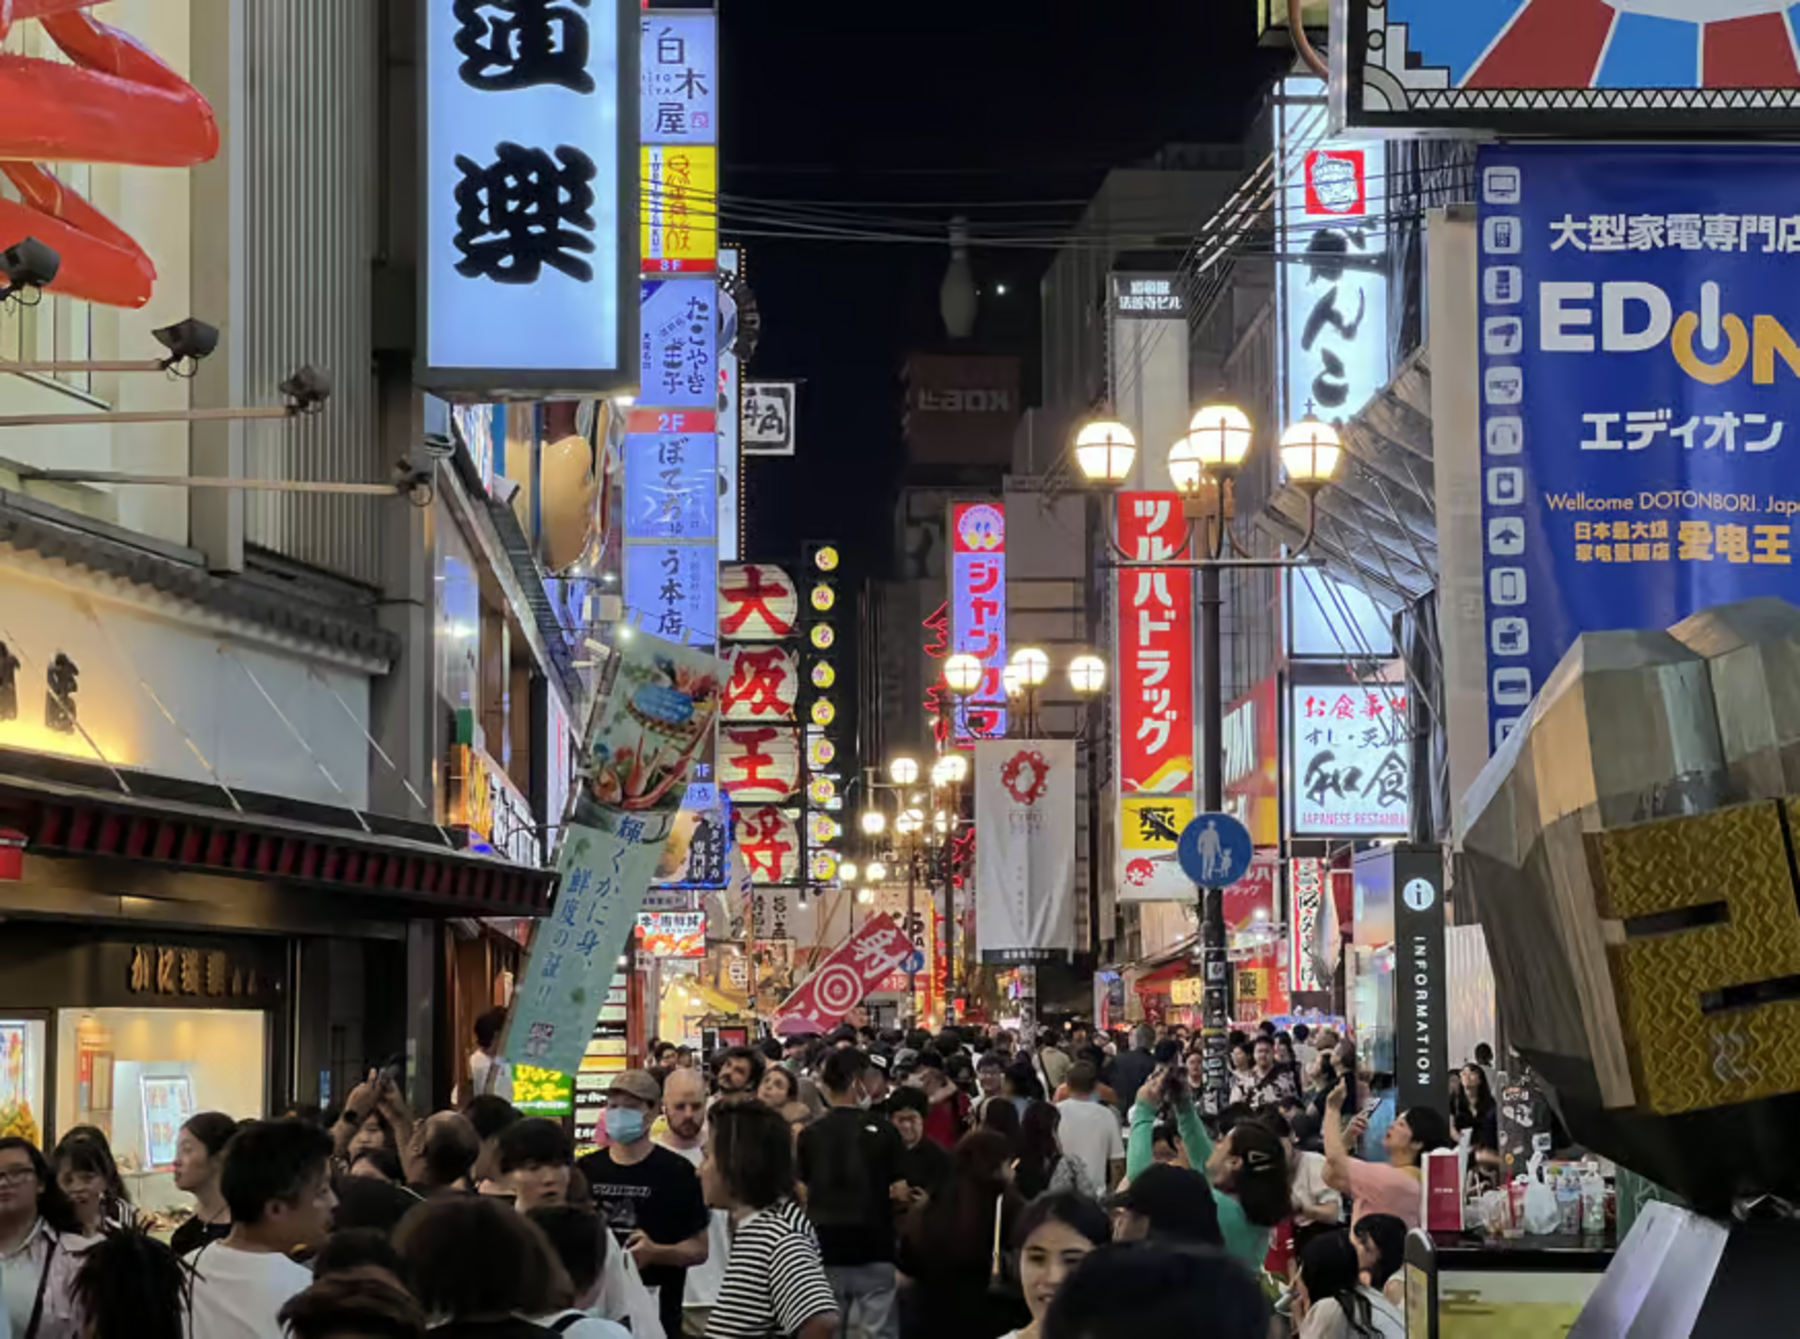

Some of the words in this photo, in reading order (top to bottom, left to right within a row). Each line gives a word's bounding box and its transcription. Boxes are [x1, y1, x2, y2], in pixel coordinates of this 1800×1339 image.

[655, 27, 709, 134] 白木屋
[661, 259, 682, 271] 3F
[1539, 281, 1800, 384] EDION
[658, 414, 684, 432] 2F
[1580, 408, 1784, 452] エディオン
[1546, 491, 1634, 511] Wellcome
[1765, 495, 1800, 518] Jap
[1133, 500, 1177, 754] ツルハドラッグ
[719, 565, 792, 883] 大阪王将
[1303, 750, 1407, 808] 和食
[1303, 812, 1350, 825] JAPANESE
[1413, 936, 1430, 1085] INFORMATION
